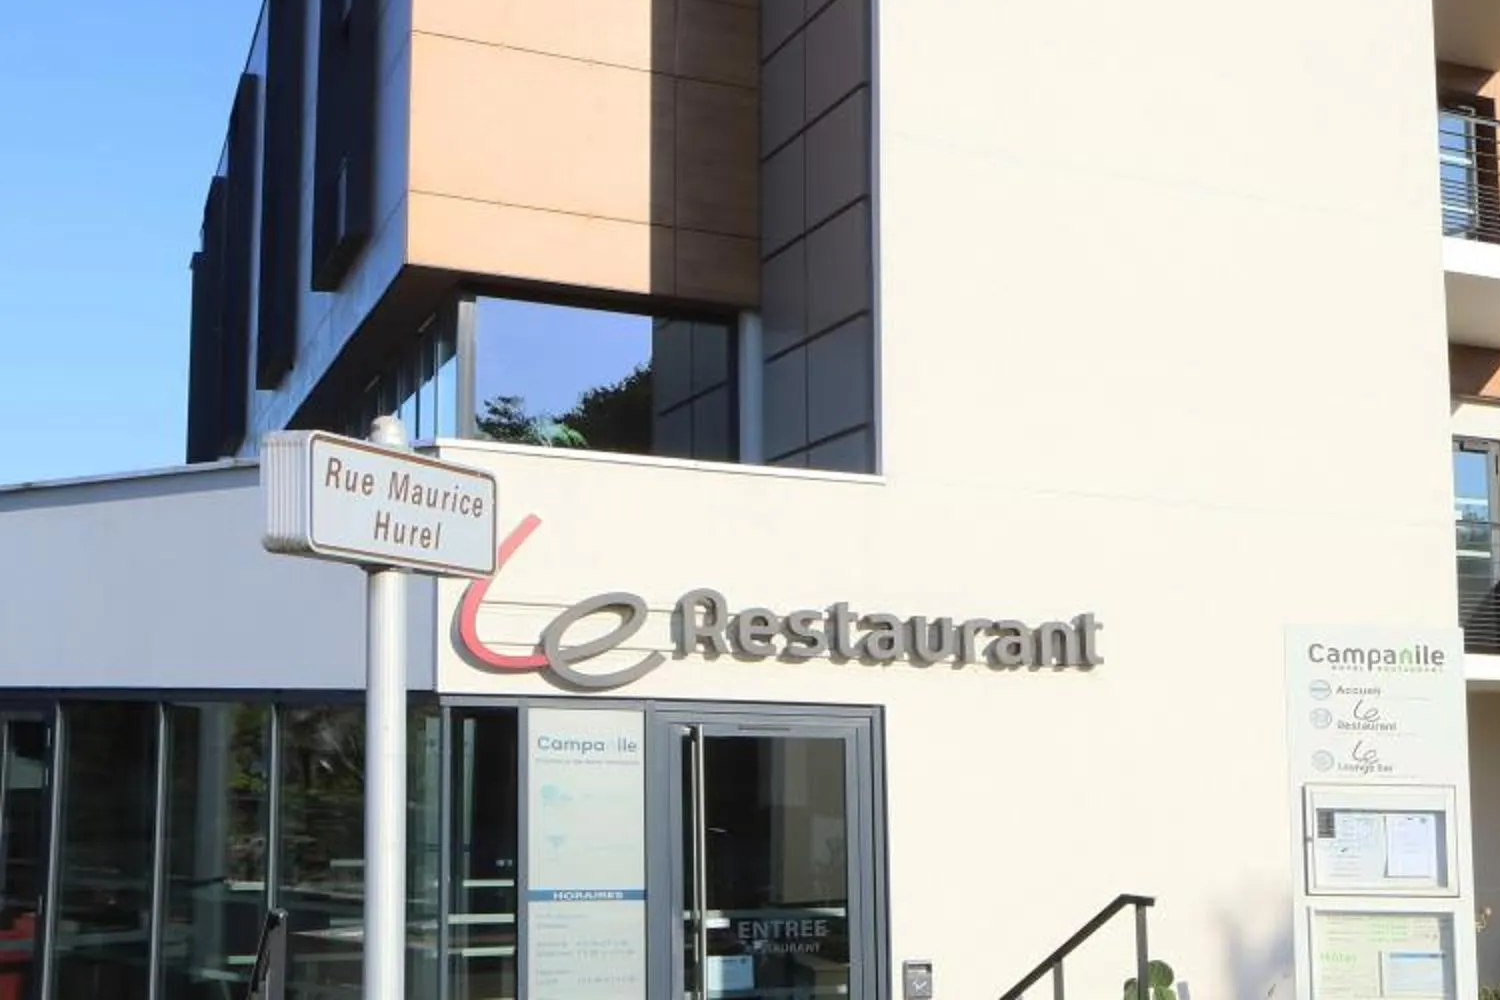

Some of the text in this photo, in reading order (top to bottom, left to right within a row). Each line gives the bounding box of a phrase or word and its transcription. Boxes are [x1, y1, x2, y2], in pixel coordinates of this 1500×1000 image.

[325, 457, 484, 518] Rue Maurice
[374, 510, 442, 550] Hurel
[675, 588, 1103, 670] Restaurant
[1308, 643, 1446, 671] Campanile
[537, 735, 638, 755] Campaile
